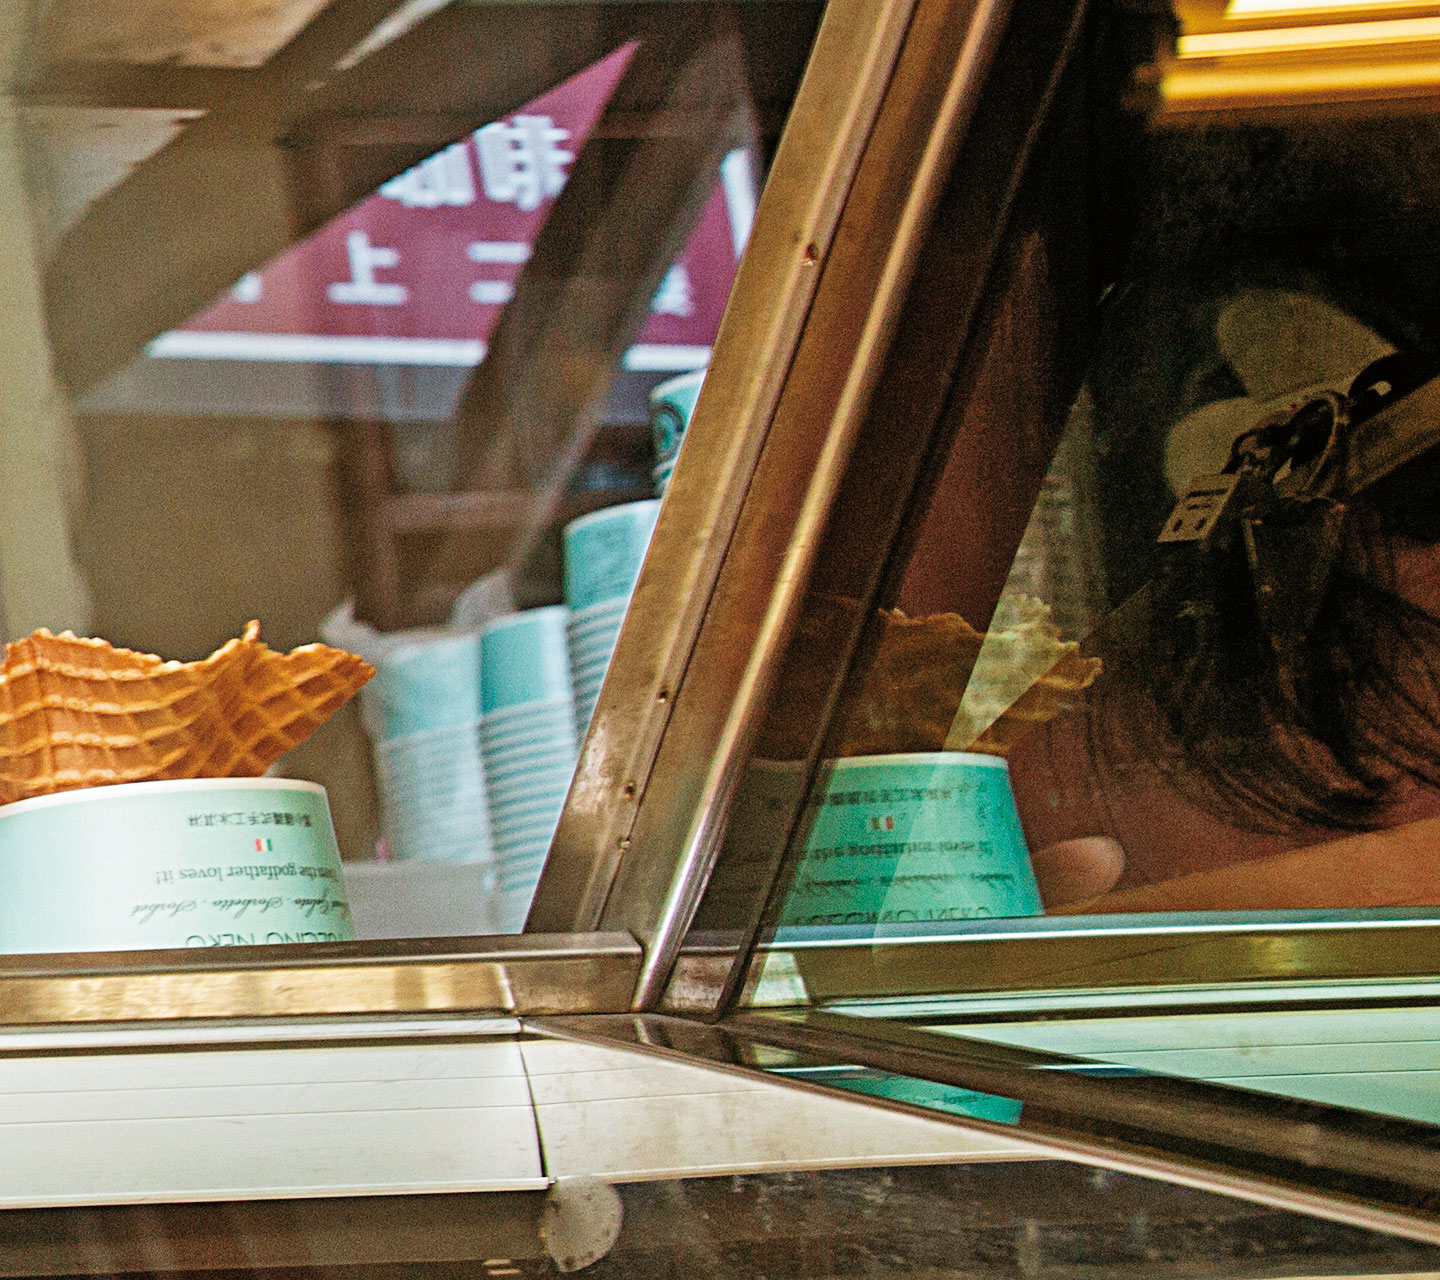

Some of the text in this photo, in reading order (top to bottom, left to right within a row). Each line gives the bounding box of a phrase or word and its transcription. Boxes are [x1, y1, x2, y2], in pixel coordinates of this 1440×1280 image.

[155, 869, 174, 885] it!
[179, 867, 223, 882] loves
[227, 863, 296, 881] godfather
[130, 900, 197, 925] Sorbet
[212, 896, 283, 919] Sorbetto
